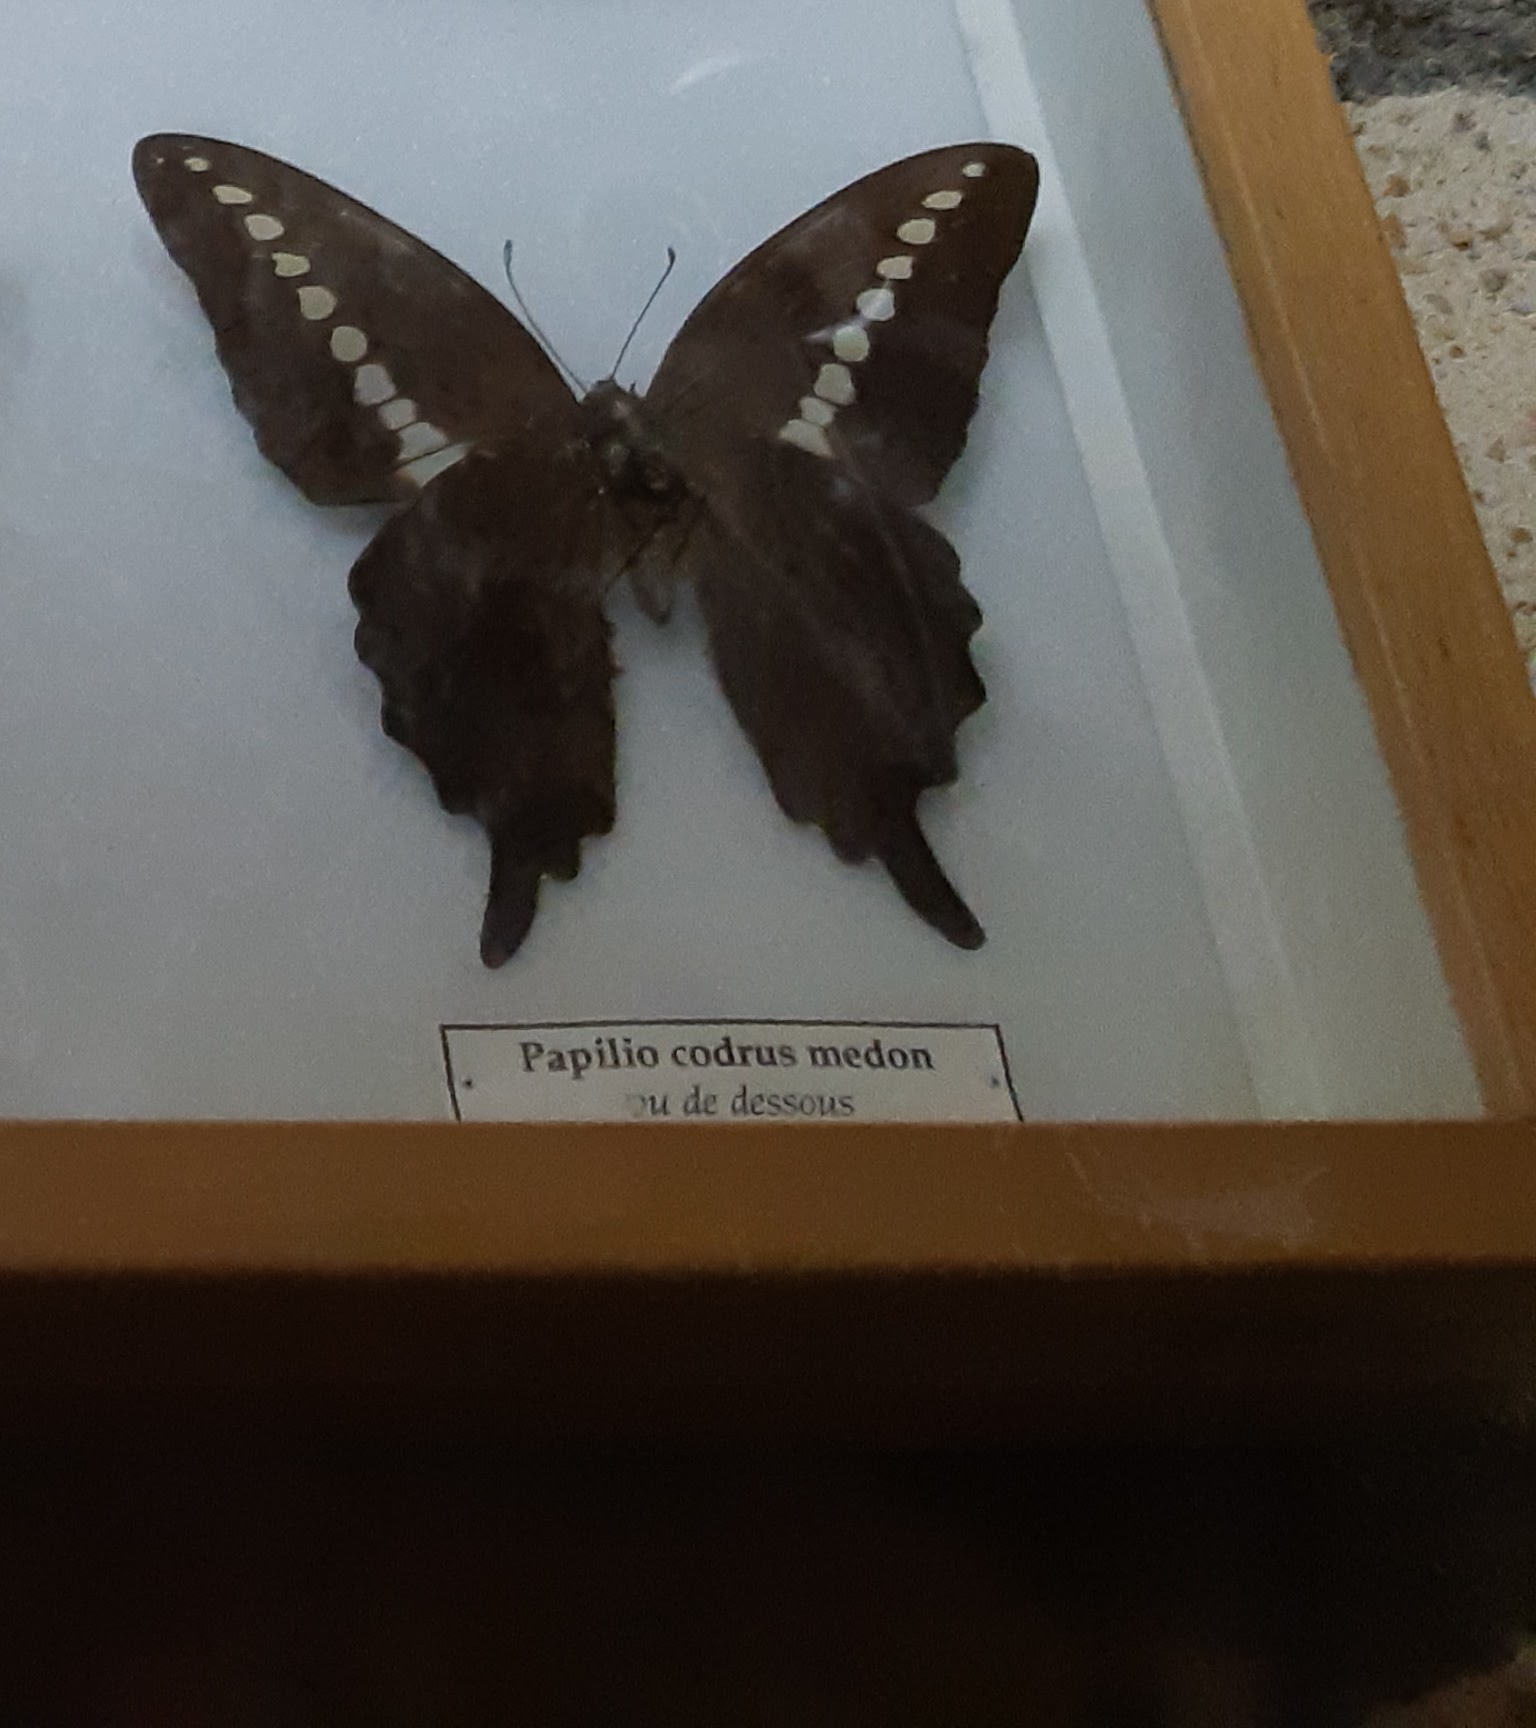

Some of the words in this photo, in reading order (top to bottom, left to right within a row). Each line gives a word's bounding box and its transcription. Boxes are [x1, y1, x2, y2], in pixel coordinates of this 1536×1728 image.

[521, 1038, 659, 1079] Papilio
[671, 1039, 797, 1069] codrus
[808, 1041, 935, 1071] medon
[682, 1087, 718, 1116] de
[730, 1085, 856, 1118] dessous
